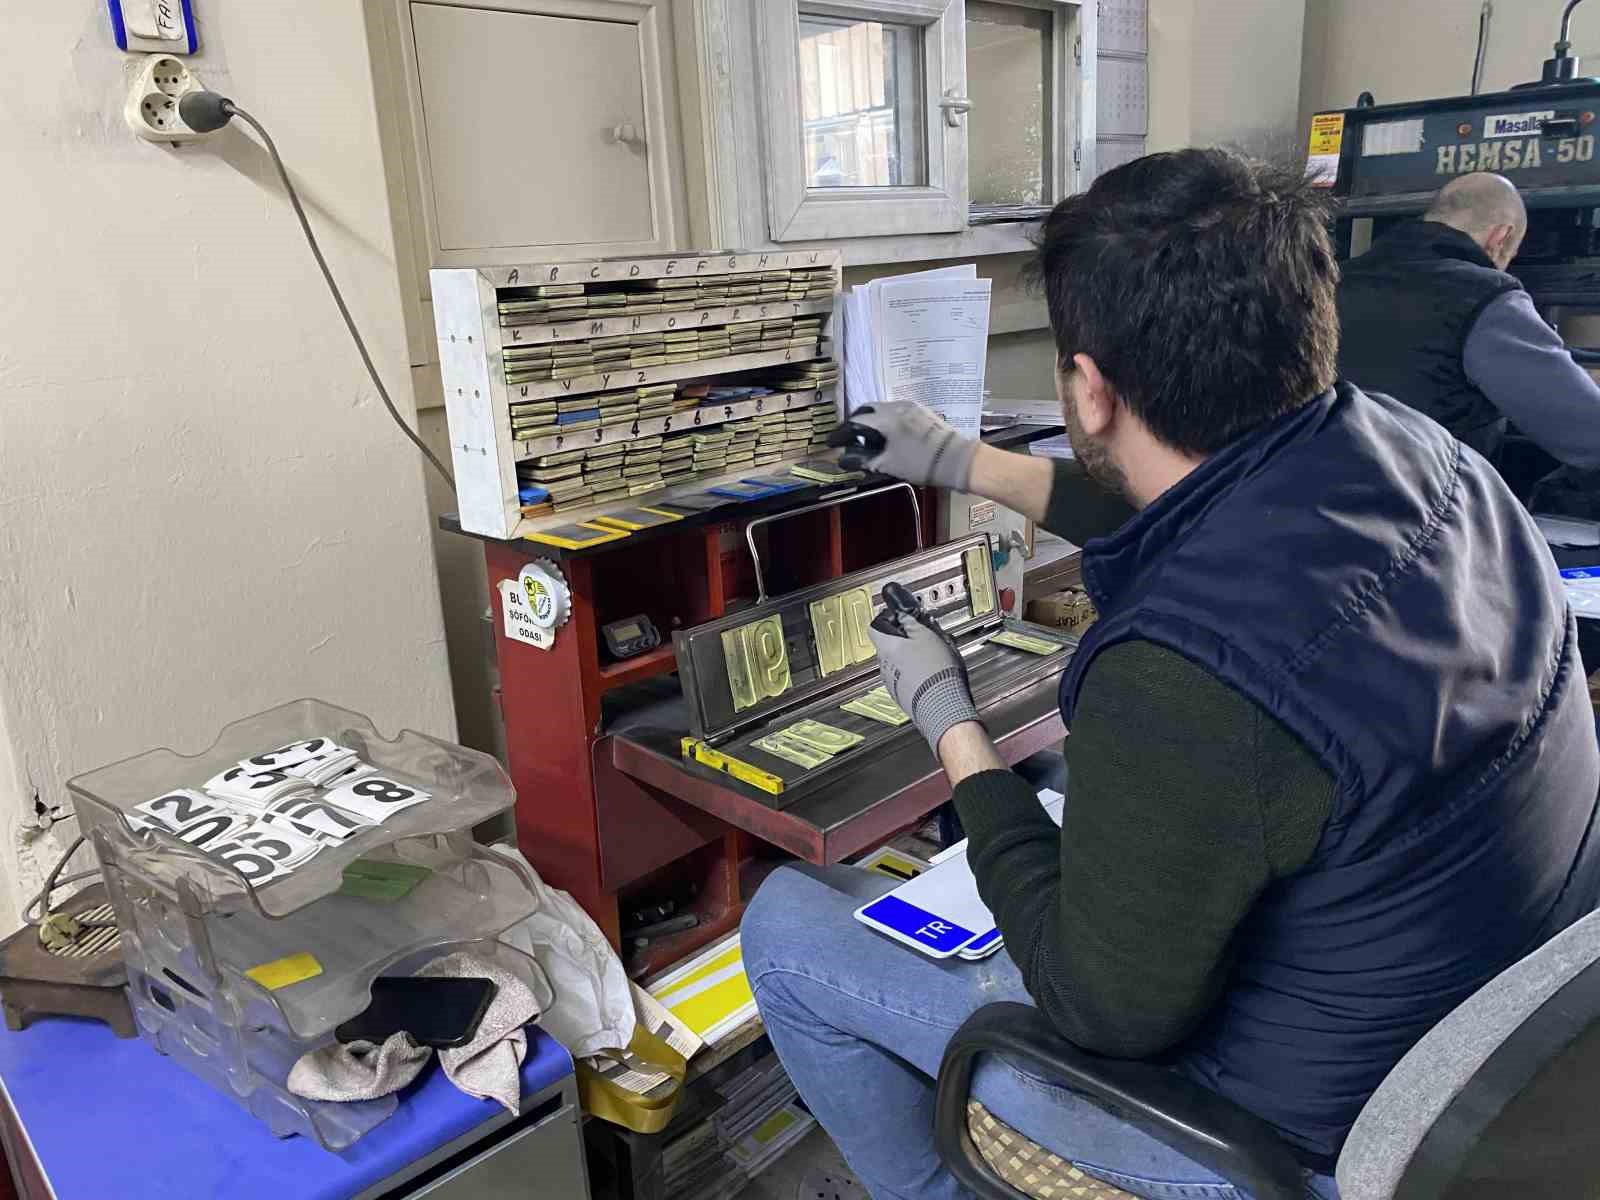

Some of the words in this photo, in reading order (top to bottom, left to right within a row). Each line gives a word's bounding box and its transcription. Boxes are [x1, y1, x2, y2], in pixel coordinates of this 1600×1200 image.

[159, 0, 175, 29] FA
[1435, 138, 1541, 174] HEMSA
[508, 269, 519, 283] A
[550, 267, 559, 280] B
[590, 267, 600, 278] C
[630, 265, 640, 276] D
[666, 261, 677, 274] E
[697, 261, 708, 273] F
[759, 254, 768, 266] H
[512, 330, 522, 341] K
[553, 329, 559, 338] L
[591, 323, 603, 334] M
[632, 317, 640, 330] N
[701, 312, 709, 324] P
[760, 307, 768, 317] S
[793, 304, 800, 315] T
[595, 428, 603, 442] 3
[632, 420, 640, 437] 4
[664, 416, 672, 431] 5
[694, 409, 701, 425] 6
[724, 406, 734, 419] 7
[519, 627, 541, 641] ODASI
[352, 780, 415, 803] 8
[150, 795, 214, 823] 2
[290, 803, 359, 829] 7
[915, 920, 952, 939] TR
